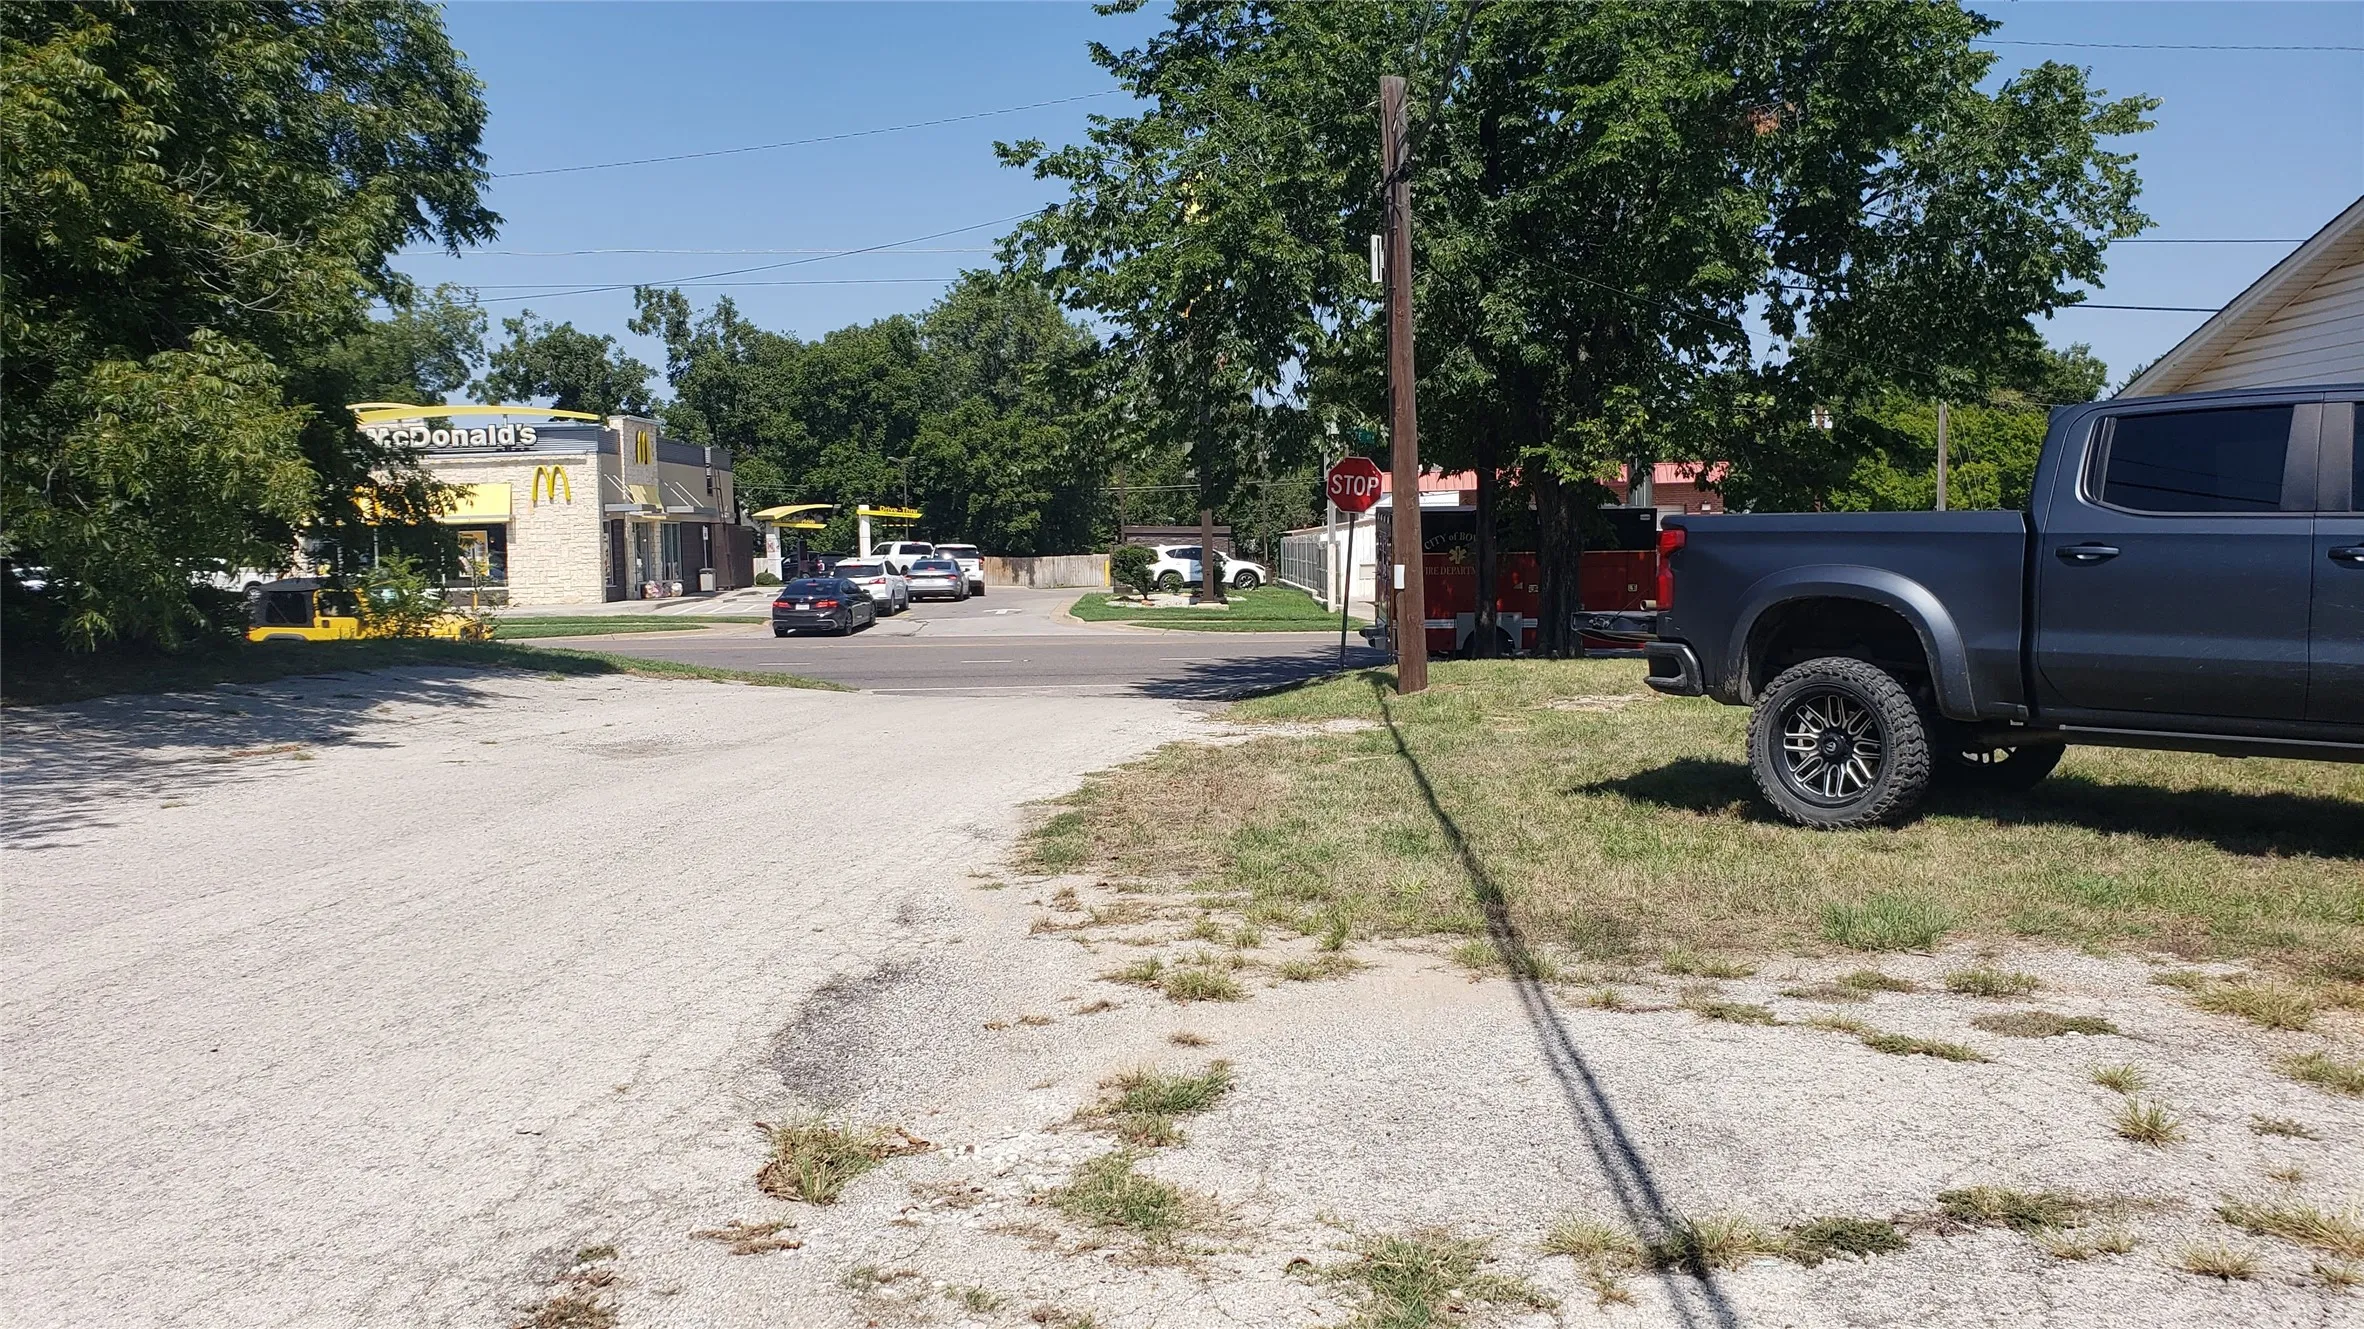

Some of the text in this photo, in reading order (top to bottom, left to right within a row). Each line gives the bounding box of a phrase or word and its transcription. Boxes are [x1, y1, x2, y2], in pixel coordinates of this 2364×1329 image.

[366, 423, 538, 448] McDonald's
[1331, 473, 1380, 497] STOP
[1424, 533, 1446, 550] CITY
[1448, 531, 1459, 541] of
[1424, 566, 1439, 576] IRE
